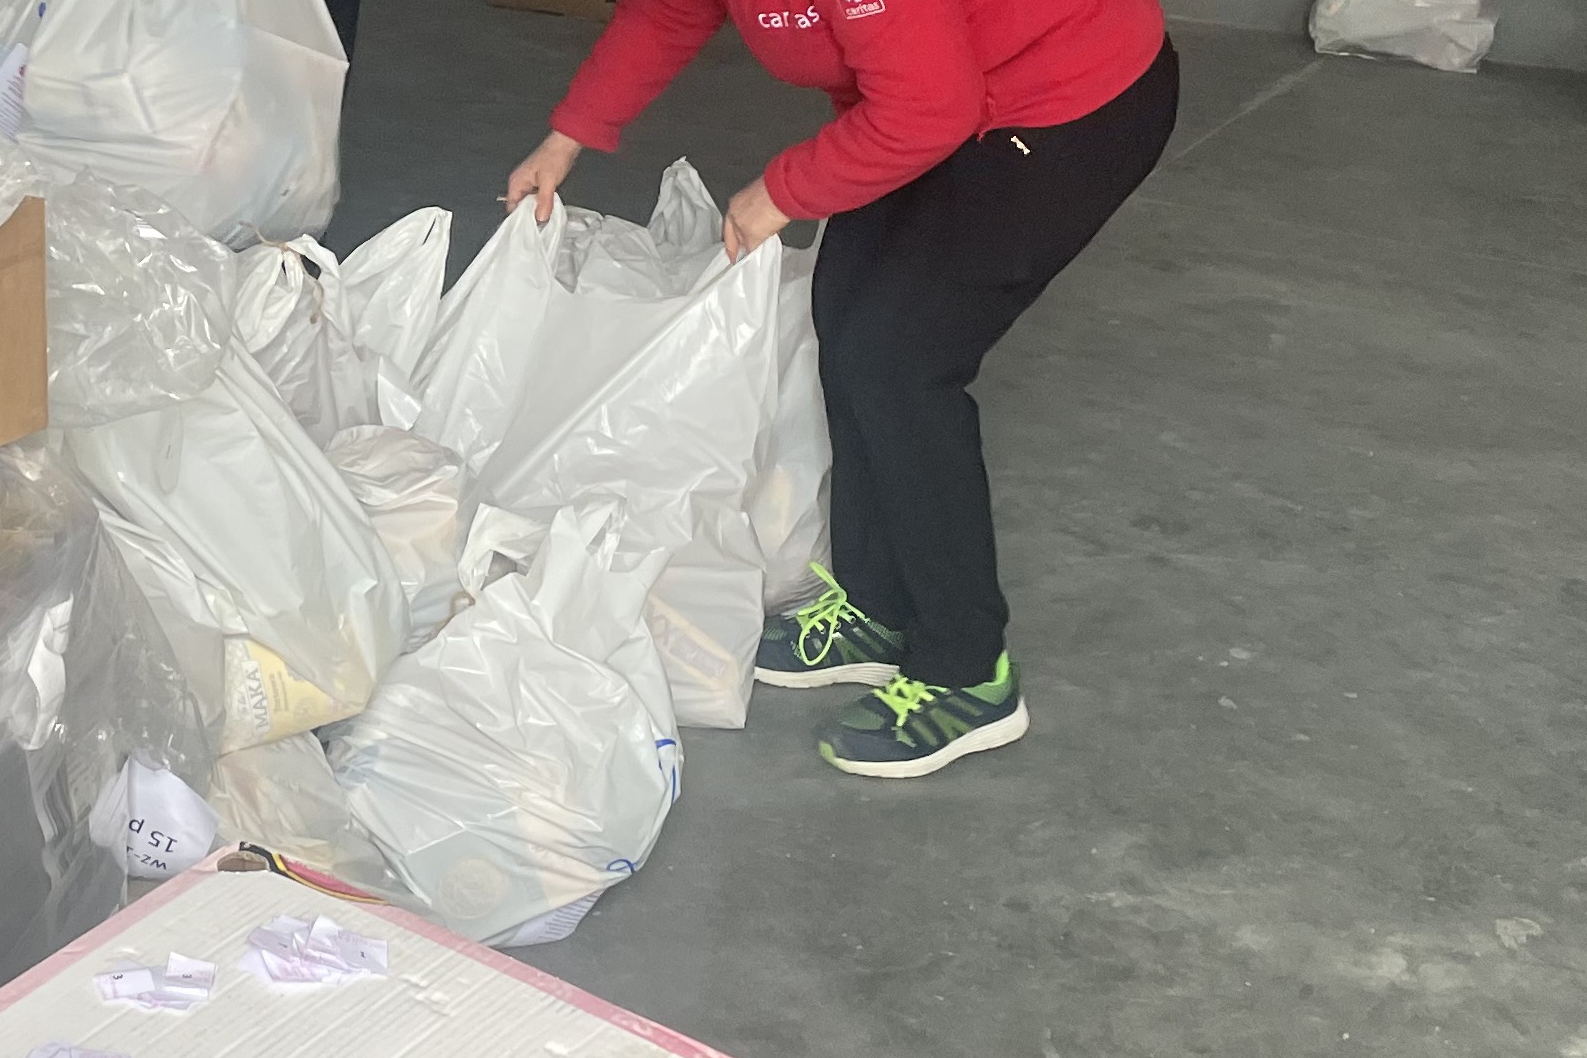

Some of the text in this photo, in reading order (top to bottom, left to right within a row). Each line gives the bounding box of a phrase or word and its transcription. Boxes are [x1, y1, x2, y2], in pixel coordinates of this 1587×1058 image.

[845, 1, 880, 15] caritas
[128, 818, 178, 853] 15 p
